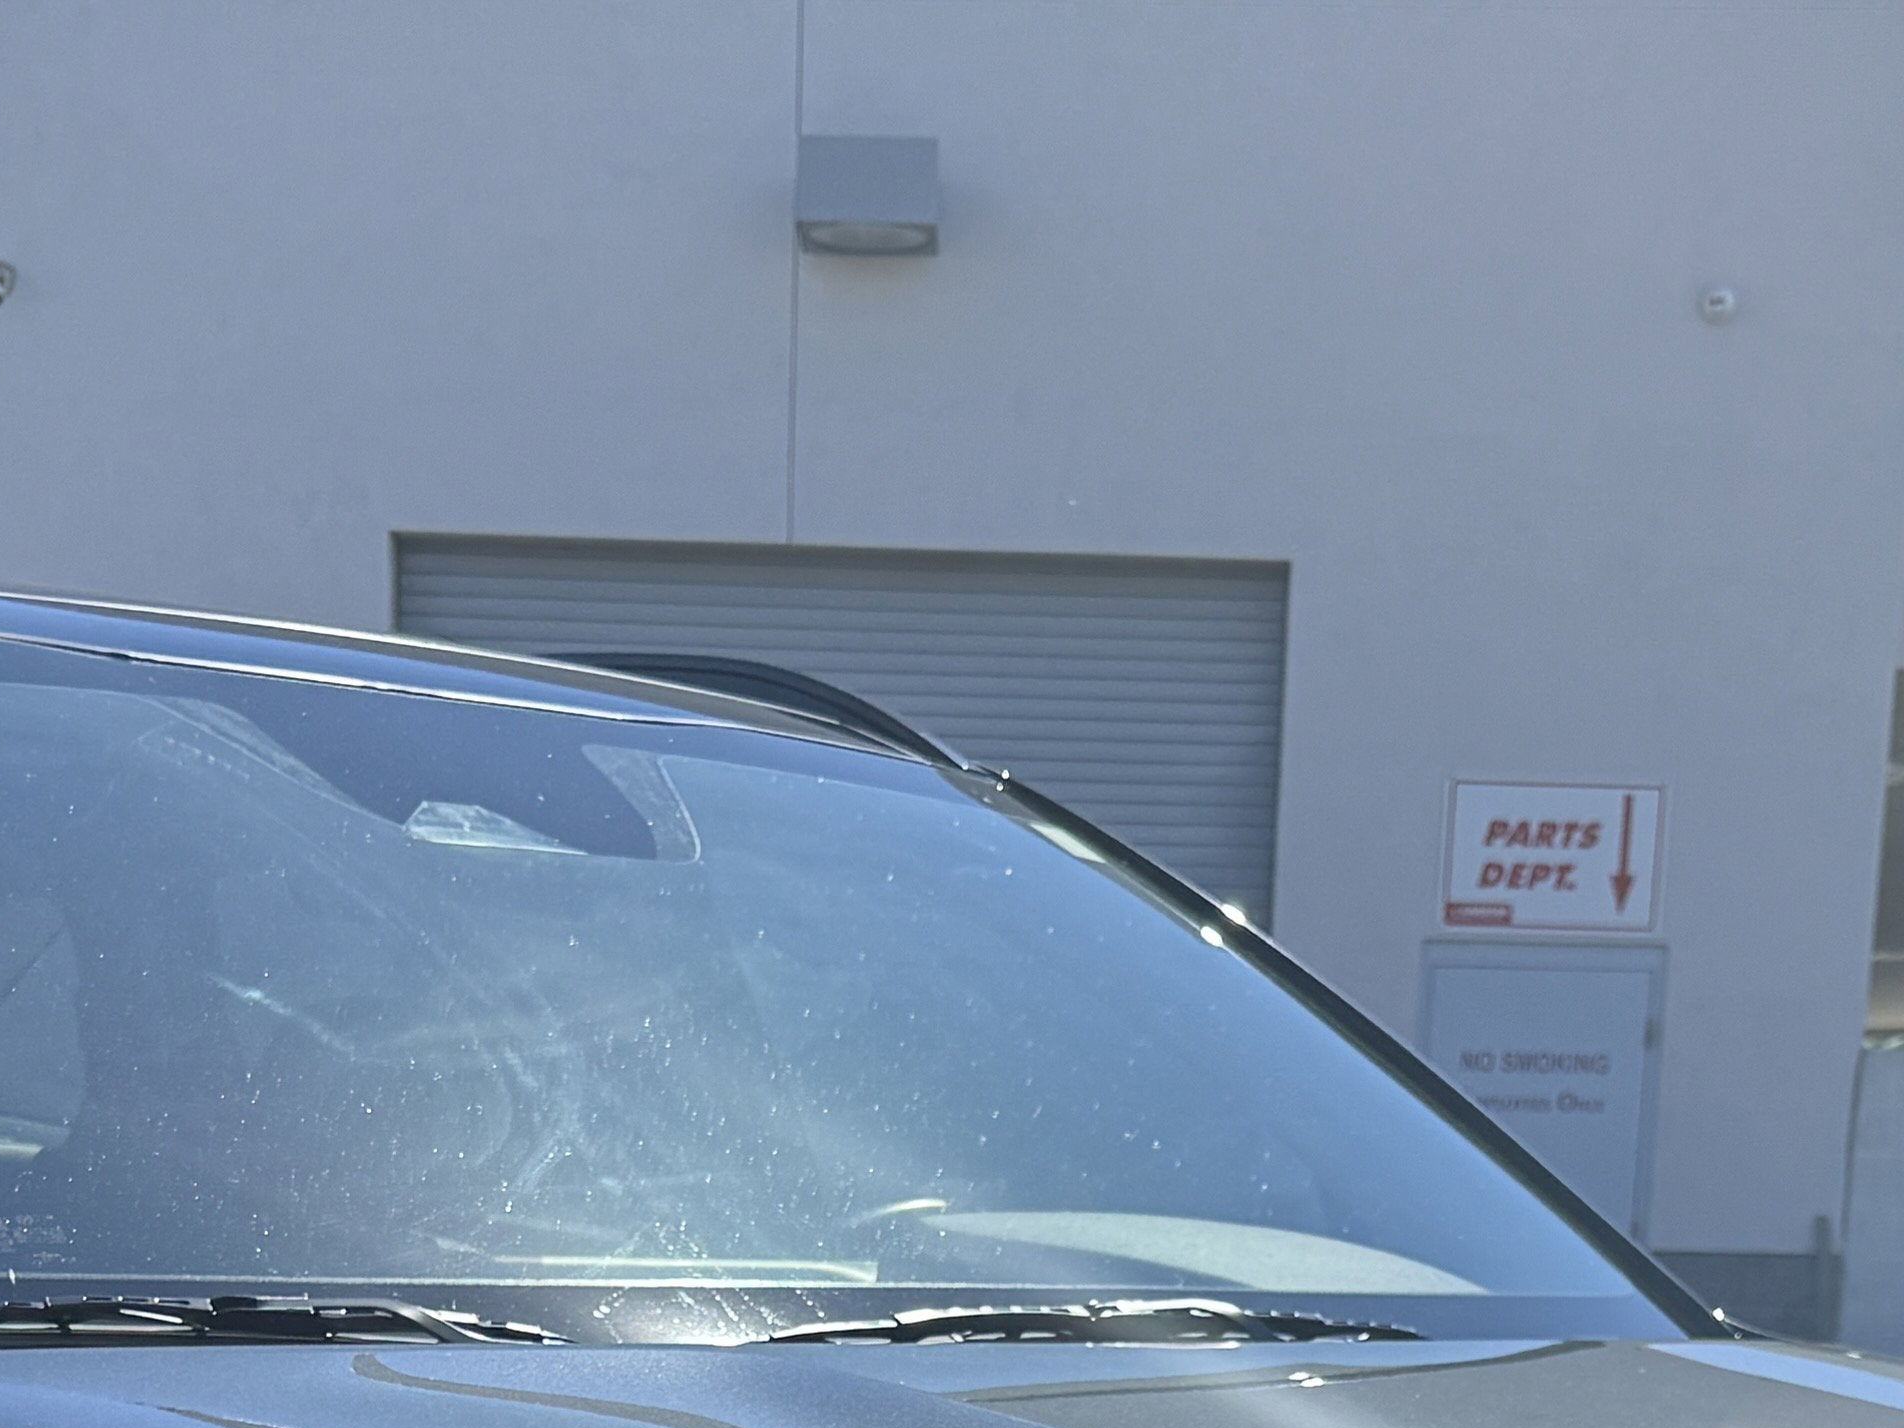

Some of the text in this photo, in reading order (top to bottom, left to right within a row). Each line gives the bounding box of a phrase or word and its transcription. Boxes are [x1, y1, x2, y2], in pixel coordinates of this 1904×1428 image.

[1483, 819, 1601, 849] PARTS
[1478, 863, 1577, 892] DEPT.
[1461, 1051, 1611, 1076] NO SMOKING
